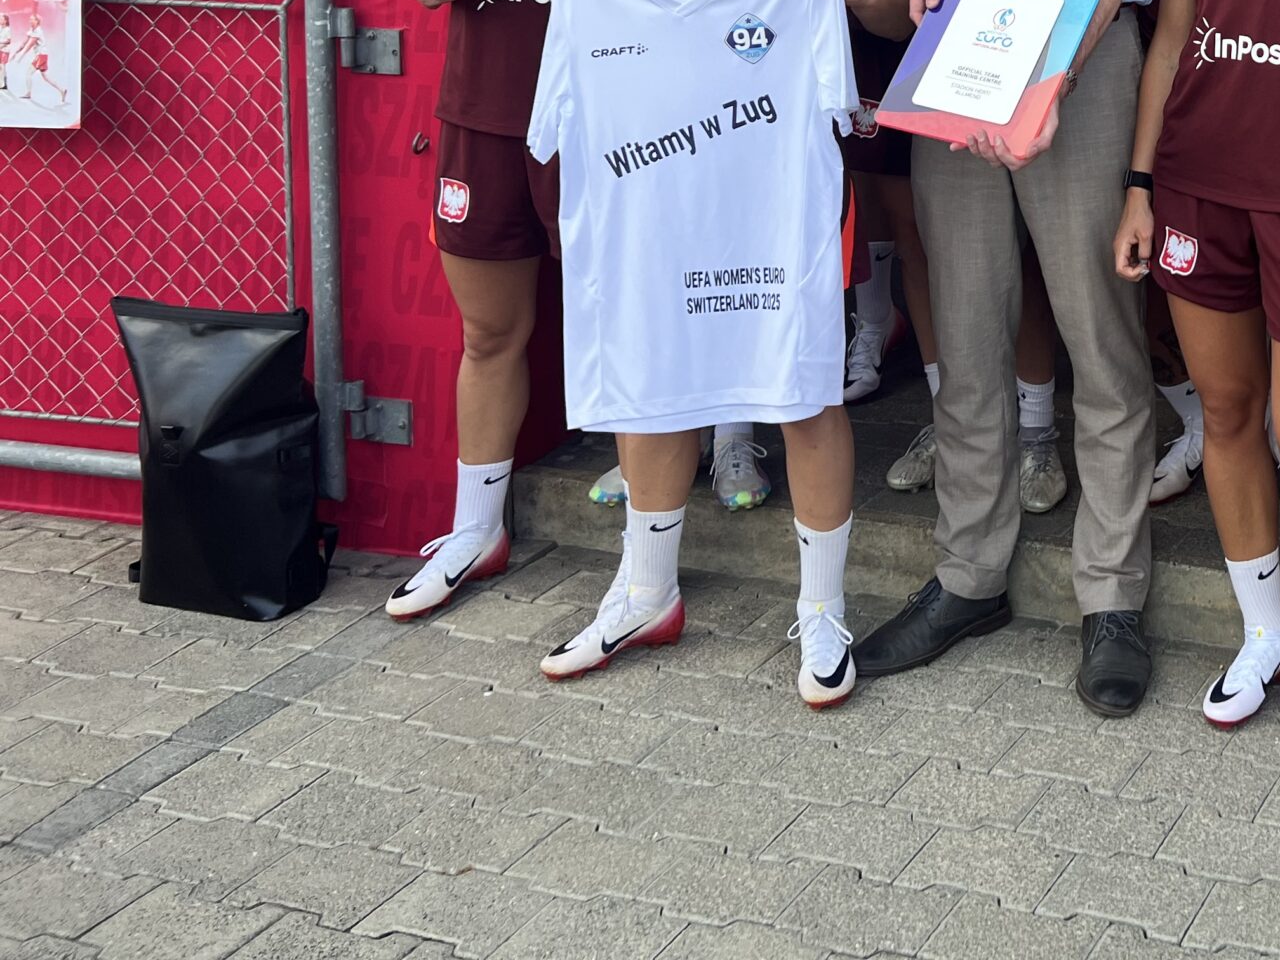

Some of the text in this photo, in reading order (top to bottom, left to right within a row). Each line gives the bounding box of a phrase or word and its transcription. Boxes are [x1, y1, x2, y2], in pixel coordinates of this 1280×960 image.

[732, 26, 769, 52] 94
[591, 46, 635, 58] CRAFT
[604, 94, 778, 178] Witamy w Zug
[684, 266, 785, 289] UEFA WOMEN'S EURO
[686, 292, 781, 315] SWITZERLAND 2025
